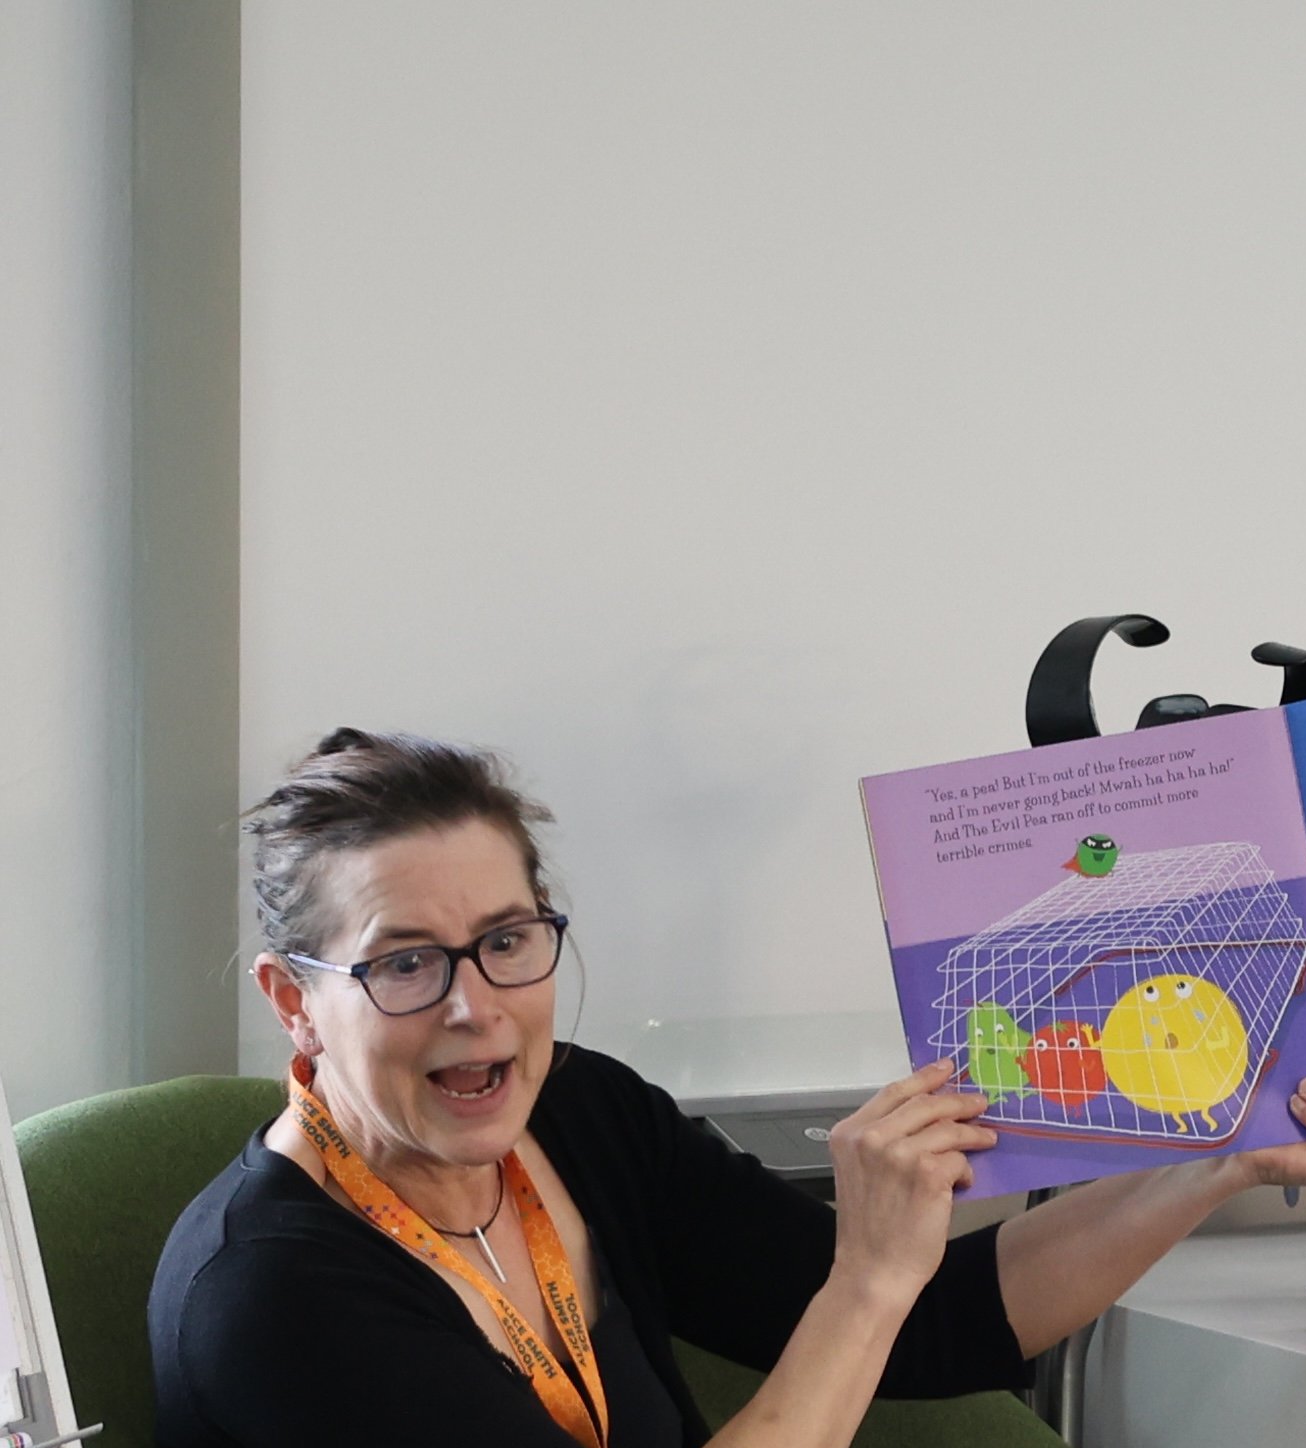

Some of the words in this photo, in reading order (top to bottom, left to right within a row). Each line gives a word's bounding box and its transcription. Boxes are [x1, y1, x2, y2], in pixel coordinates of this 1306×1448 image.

[930, 808, 955, 823] and
[958, 804, 979, 819] I'm
[982, 800, 1021, 815] never
[1024, 791, 1060, 811] going
[1061, 782, 1096, 801] back!
[1099, 775, 1143, 795] Mwah
[1145, 773, 1164, 787] ha
[1167, 769, 1185, 783] ha
[1188, 766, 1206, 779] ha
[960, 790, 969, 798] a
[972, 779, 999, 800] pea!
[1002, 775, 1026, 791] But
[1028, 772, 1050, 786] I'm
[1053, 767, 1073, 781] out
[1077, 762, 1090, 778] of
[1093, 761, 1115, 775] the
[1118, 754, 1165, 771] freezer
[1169, 748, 1196, 763] now
[934, 827, 960, 844] And
[962, 823, 988, 838] The
[991, 817, 1020, 833] Evil
[1023, 813, 1048, 828] Pea
[1051, 810, 1075, 824] ran
[1077, 803, 1095, 819] off
[1098, 803, 1111, 815] to
[1114, 792, 1163, 812] commit
[1167, 789, 1199, 804] more
[936, 844, 985, 864] terrible
[317, 1117, 350, 1159] SMITH
[547, 1281, 569, 1325] SMITH
[566, 1293, 589, 1352] SCHOOL
[502, 1317, 535, 1373] SCHOOL
[525, 1337, 557, 1379] SMITH
